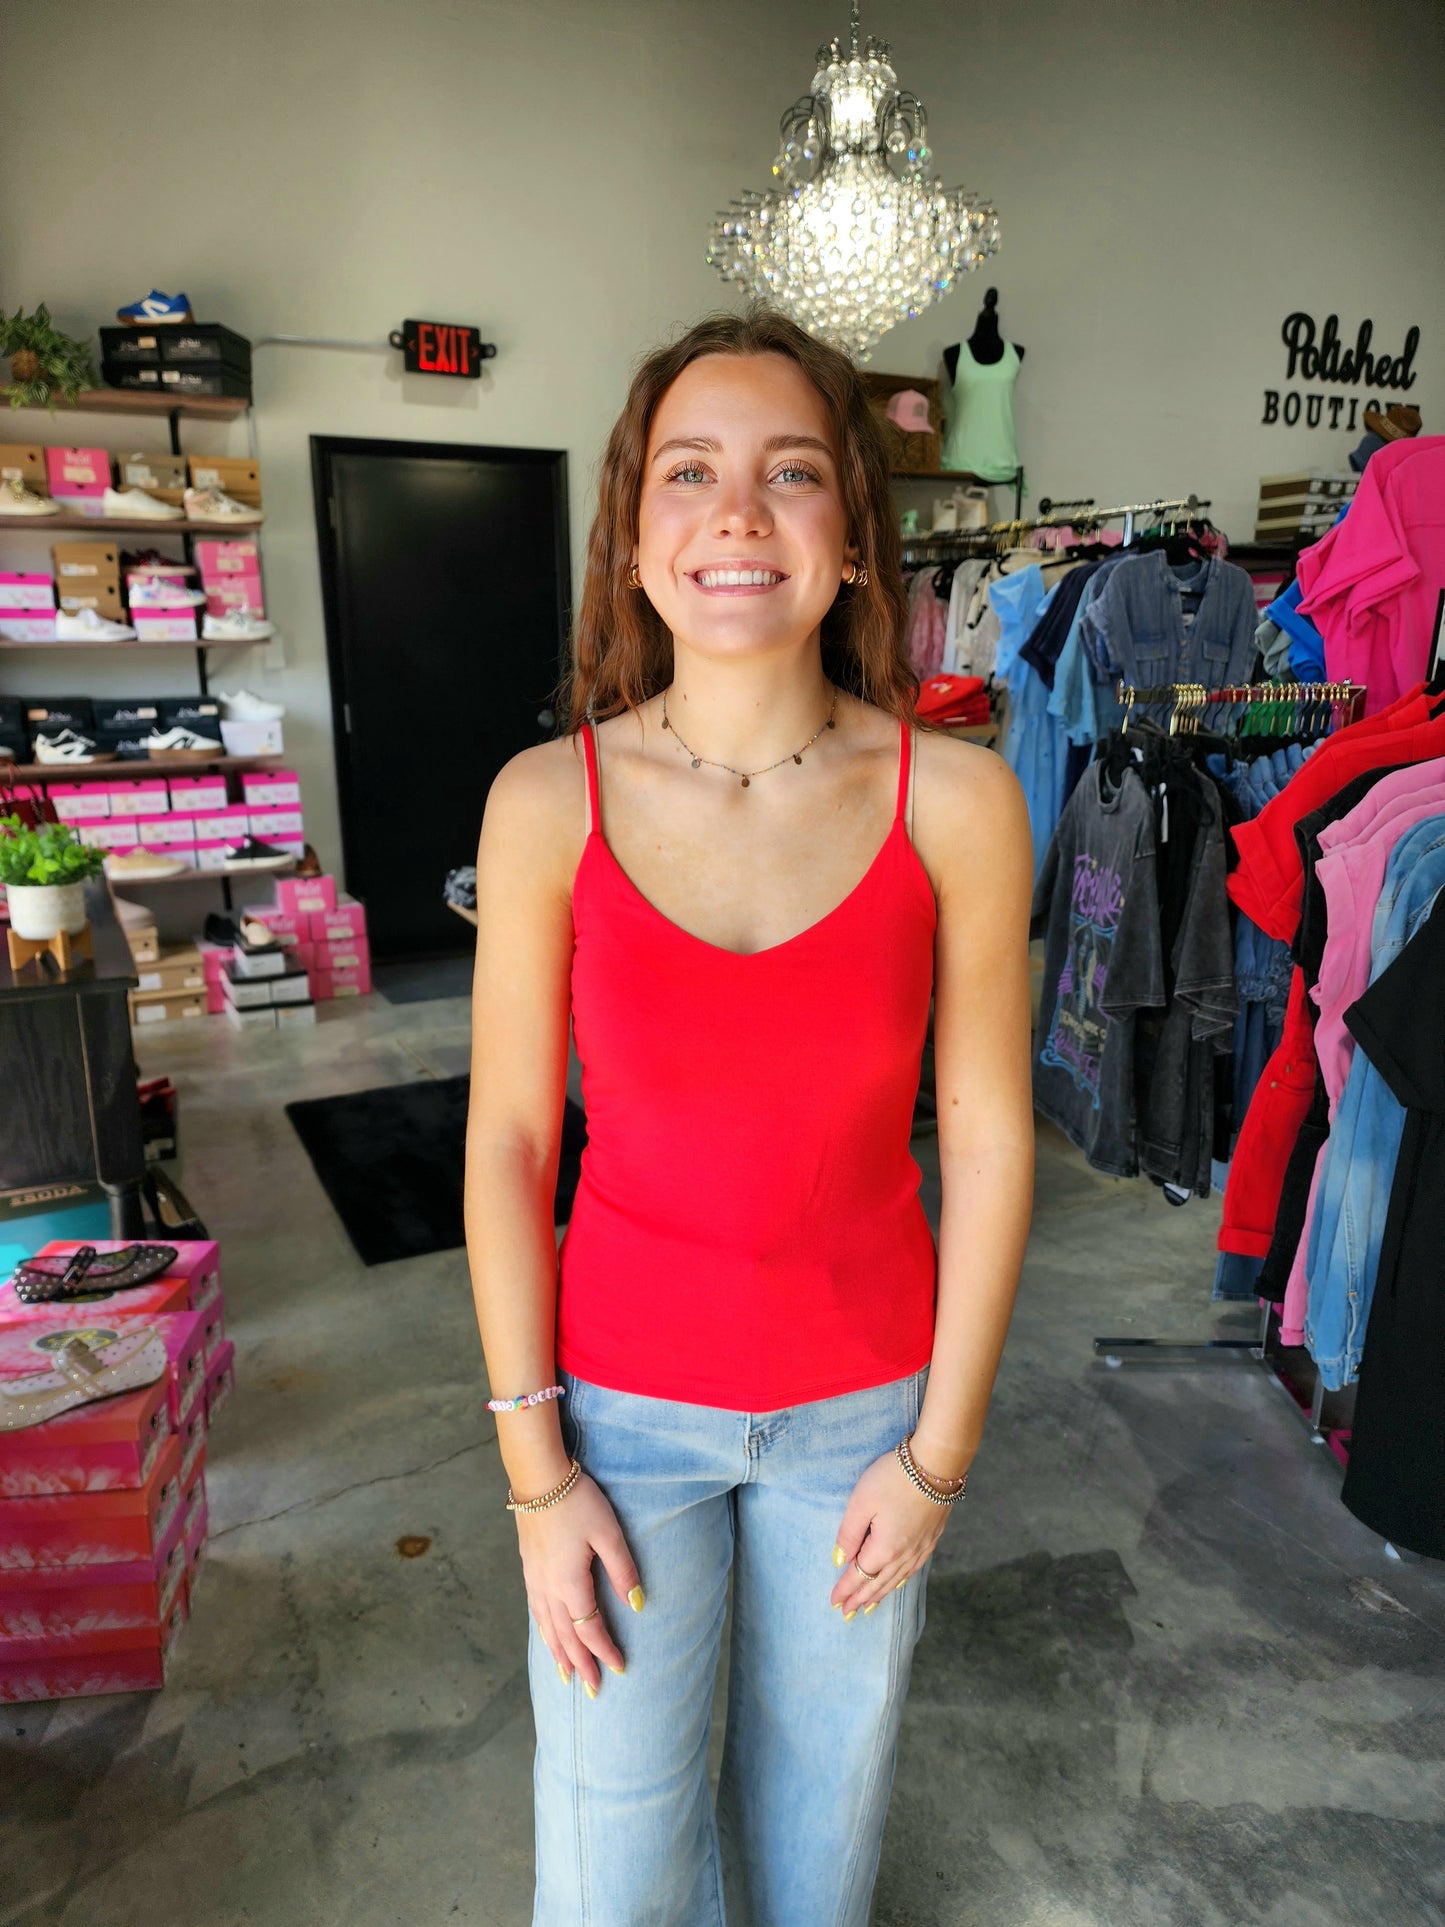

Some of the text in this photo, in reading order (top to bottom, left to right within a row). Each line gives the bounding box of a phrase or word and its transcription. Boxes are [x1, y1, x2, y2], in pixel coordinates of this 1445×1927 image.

[418, 323, 471, 375] EXIT
[1282, 312, 1420, 390] Polished
[1261, 389, 1420, 432] BOUTI
